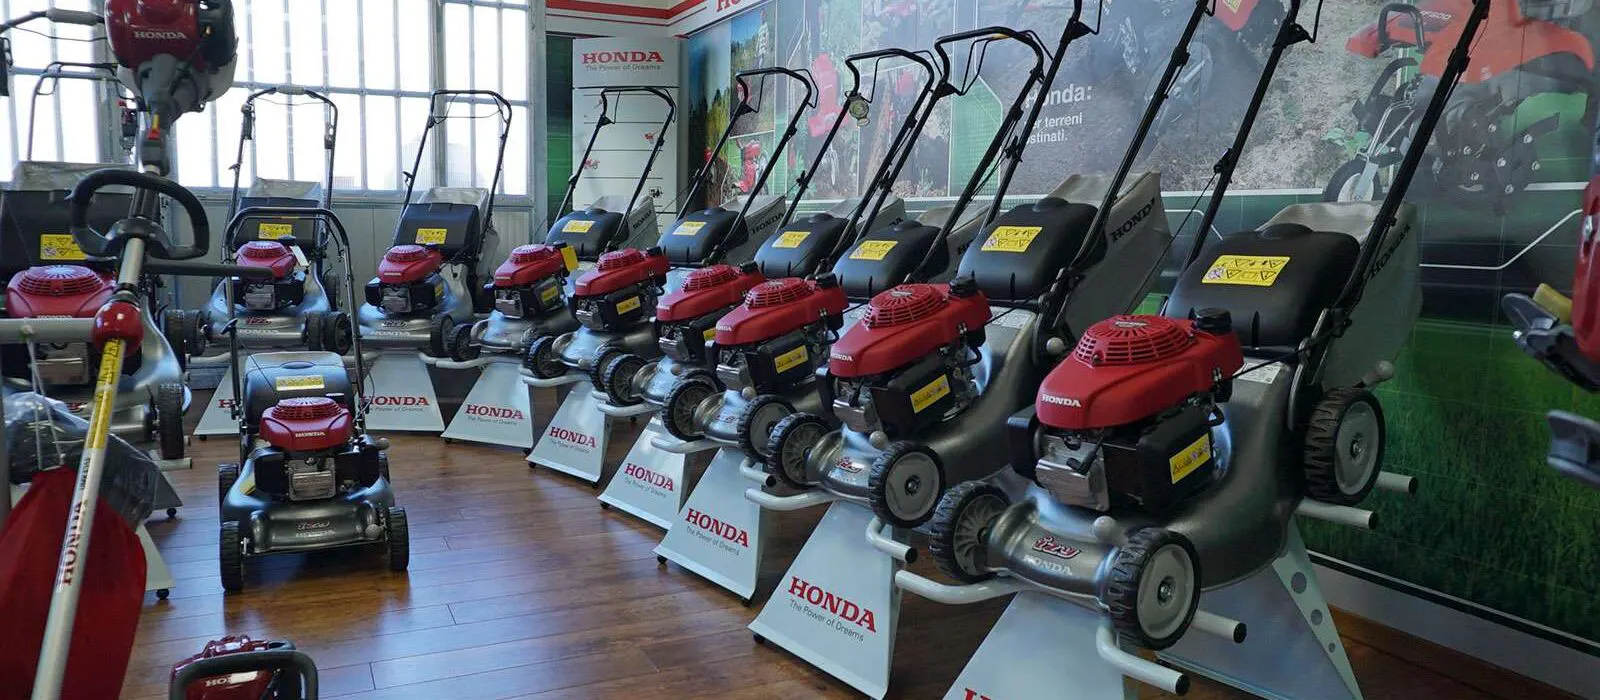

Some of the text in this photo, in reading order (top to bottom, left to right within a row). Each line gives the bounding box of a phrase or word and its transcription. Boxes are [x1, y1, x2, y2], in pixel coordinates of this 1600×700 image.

[134, 31, 190, 40] HONDA
[582, 51, 664, 64] HONDA
[1044, 112, 1083, 128] terreni
[465, 404, 523, 420] HONDA
[1041, 394, 1082, 408] HONDA
[549, 426, 596, 448] HONDA
[624, 462, 674, 492] HONDA
[685, 507, 749, 548] HONDA
[1023, 554, 1073, 576] HONDA
[788, 576, 876, 633] HONDA
[790, 598, 865, 642] The Power of Dreams
